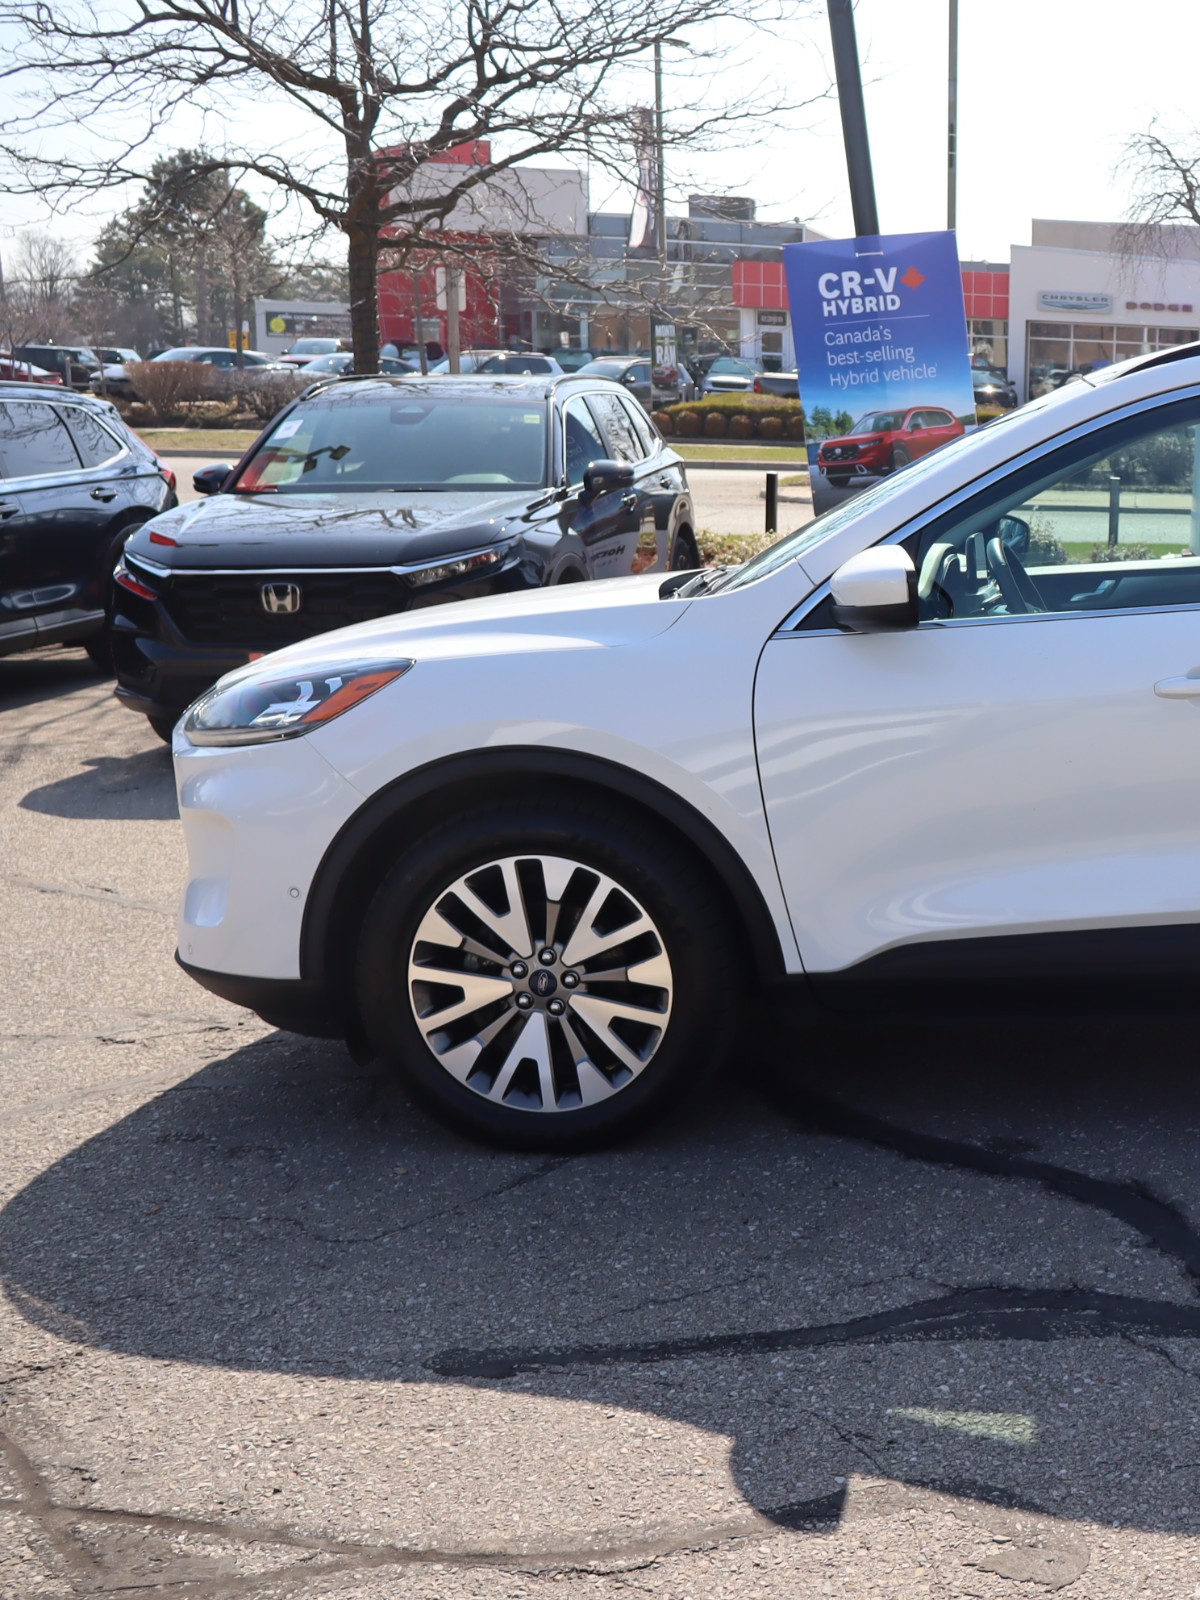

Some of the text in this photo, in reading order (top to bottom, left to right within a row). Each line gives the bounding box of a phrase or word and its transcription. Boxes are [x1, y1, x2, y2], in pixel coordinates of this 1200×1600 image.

[818, 267, 897, 299] CR-V
[822, 294, 901, 317] HYBRID
[1041, 294, 1108, 302] CHRYSLER
[1126, 301, 1193, 312] DODGE
[824, 325, 892, 346] Canada's
[827, 345, 915, 366] best-selling
[830, 368, 879, 390] Hybrid
